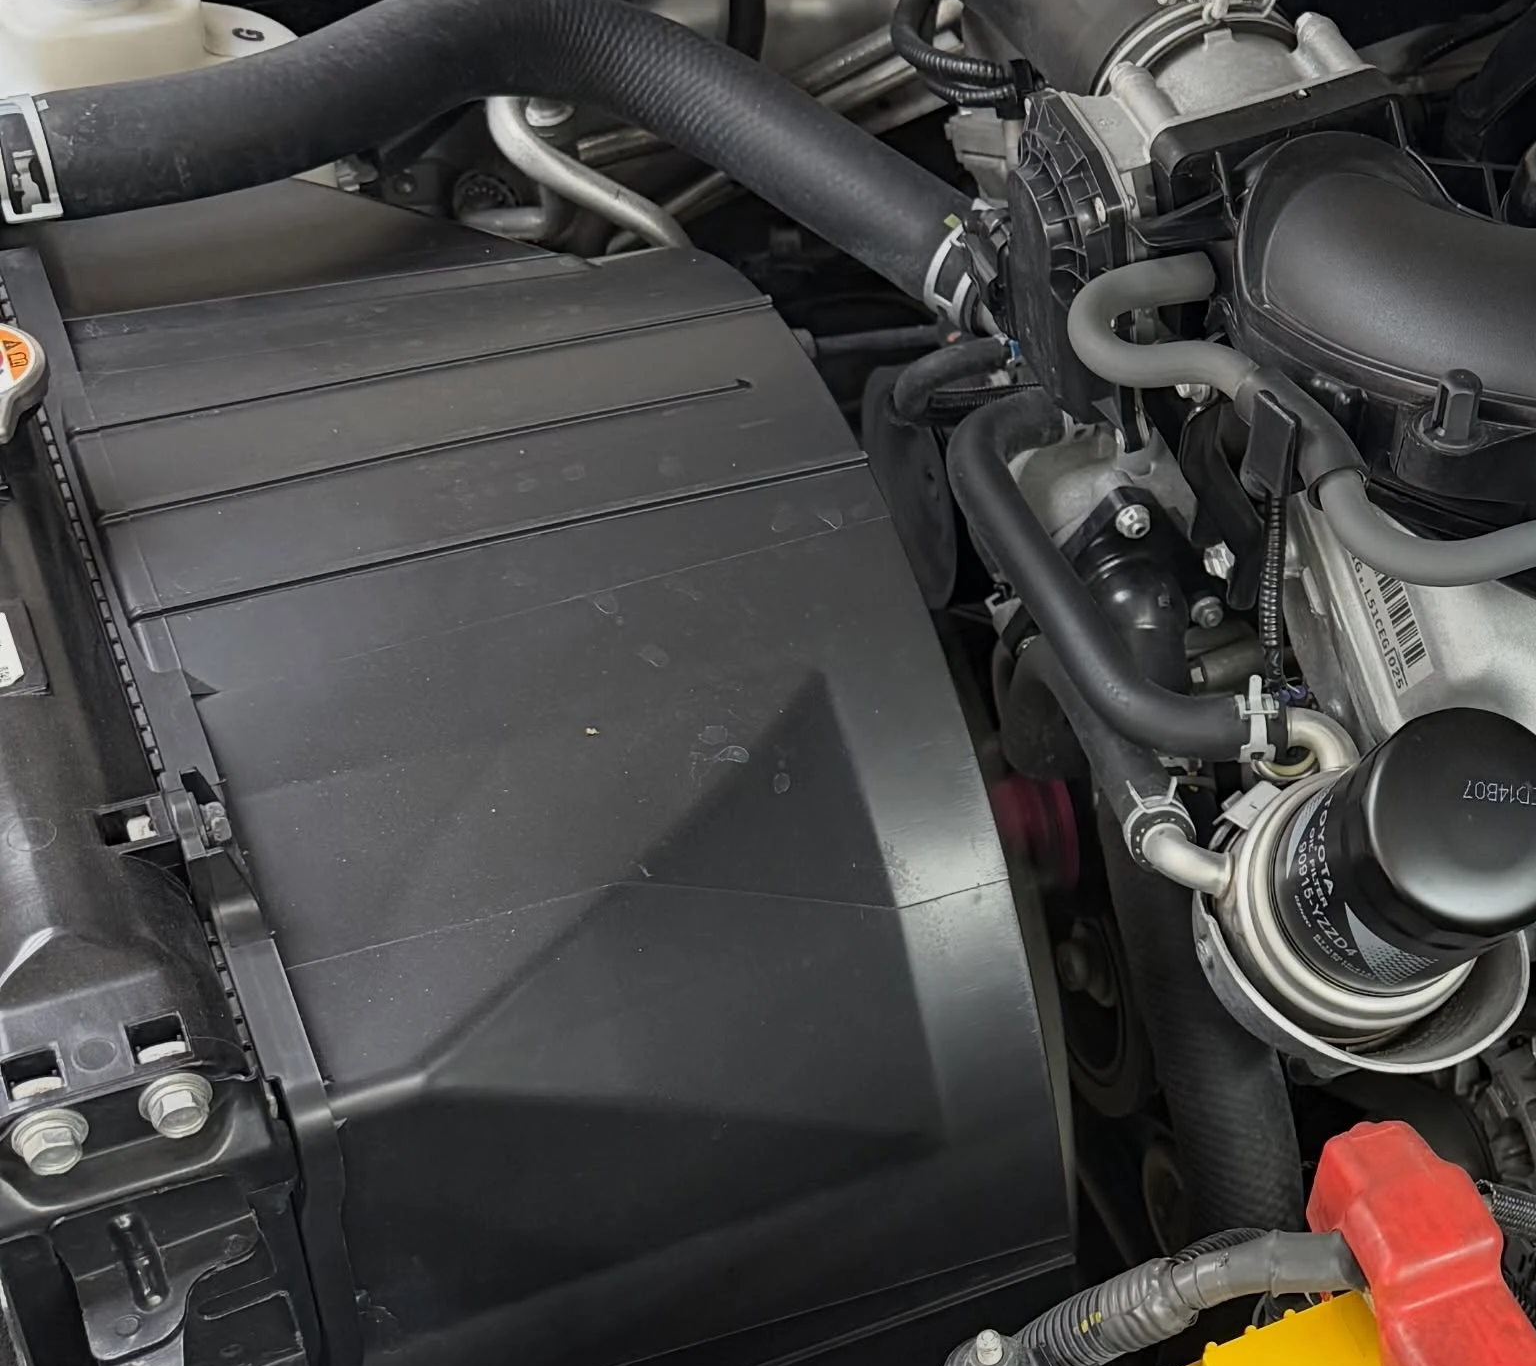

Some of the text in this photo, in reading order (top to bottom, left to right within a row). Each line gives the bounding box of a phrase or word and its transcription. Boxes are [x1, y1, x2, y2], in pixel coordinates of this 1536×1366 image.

[1307, 857, 1329, 908] FILTER
[1315, 793, 1333, 895] TOYOTA
[1296, 841, 1358, 954] 90915-YZZD4
